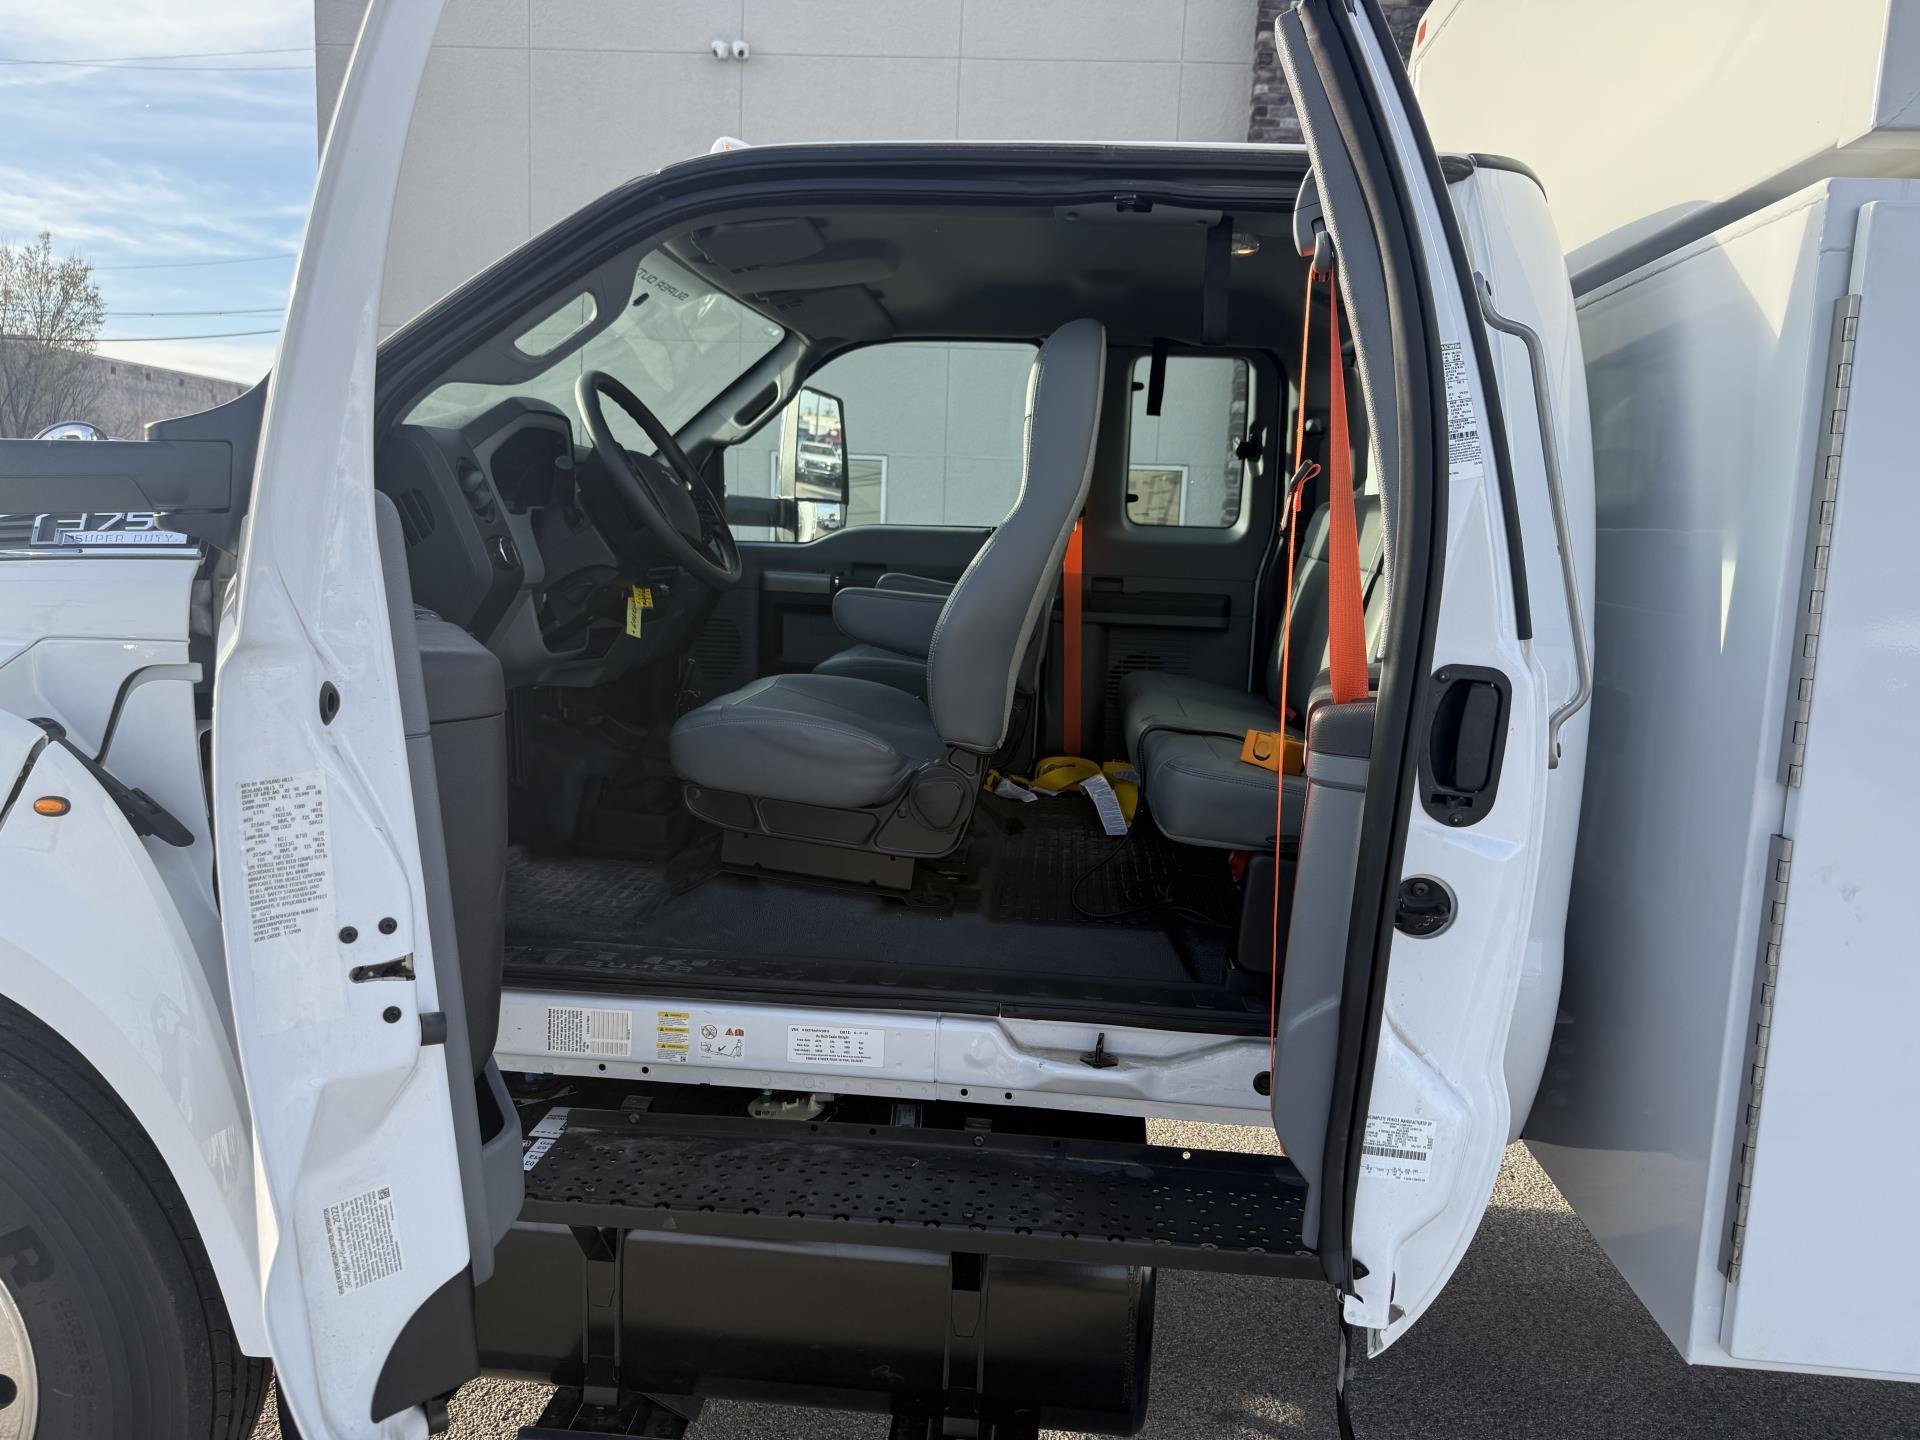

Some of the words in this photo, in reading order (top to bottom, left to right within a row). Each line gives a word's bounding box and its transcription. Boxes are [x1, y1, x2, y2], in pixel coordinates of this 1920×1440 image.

[75, 534, 124, 543] SUPER
[133, 534, 174, 543] DUTY
[330, 1206, 342, 1226] 2022
